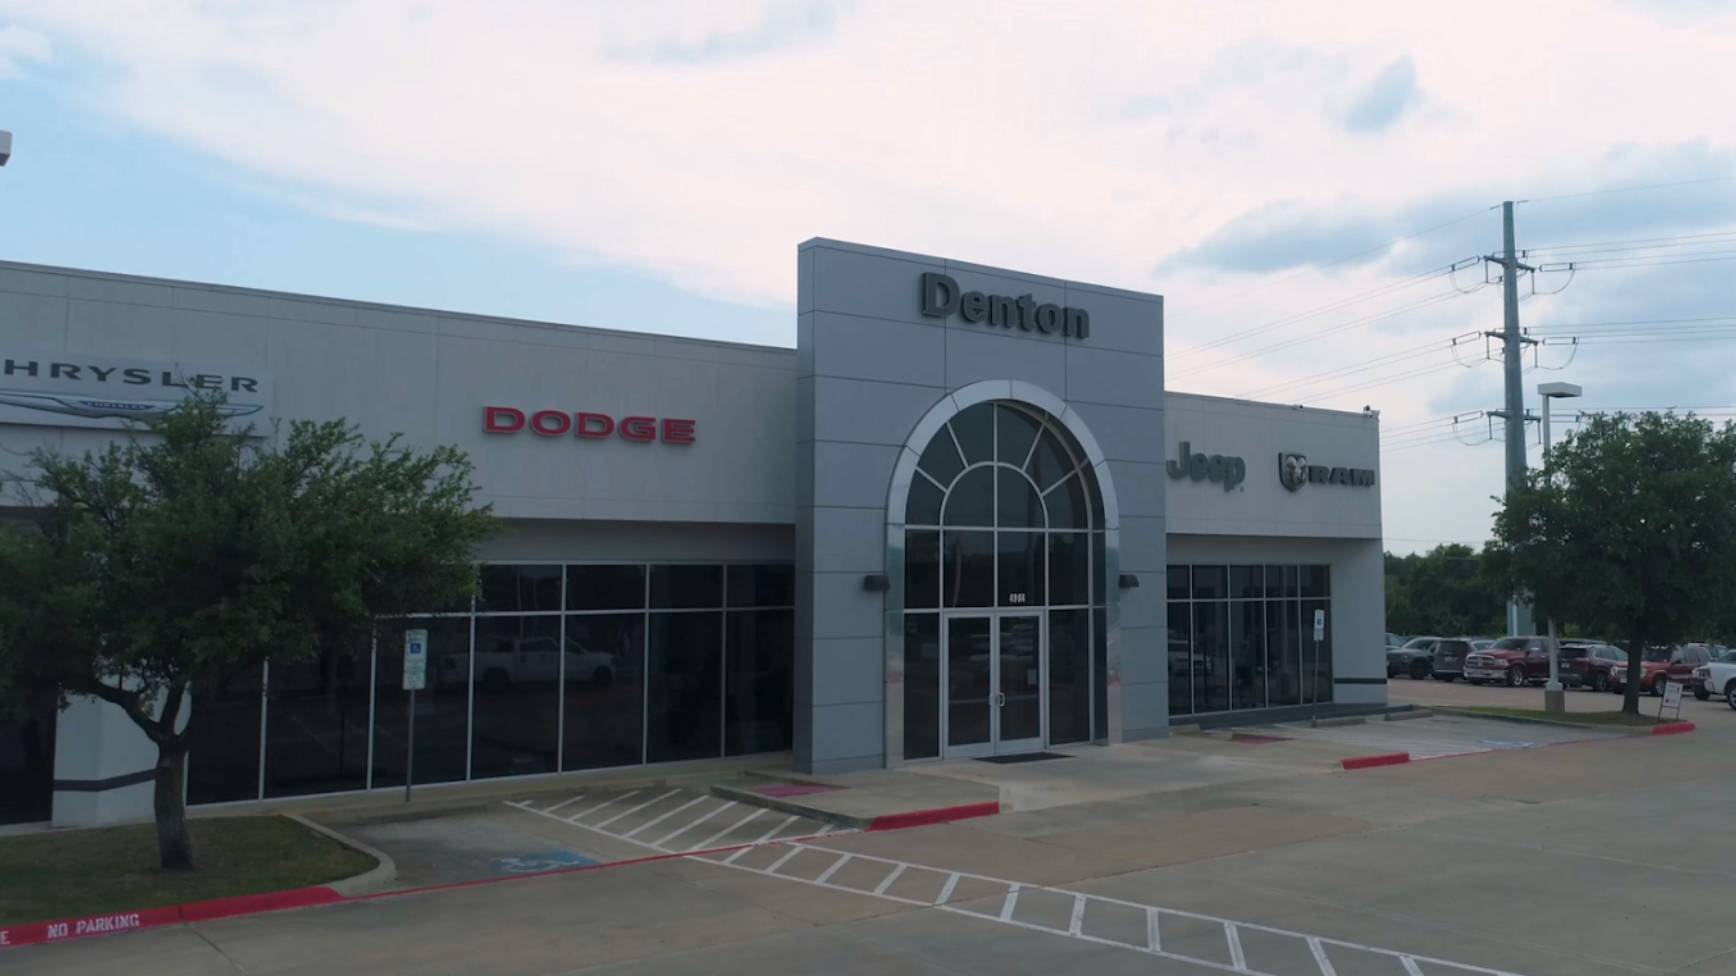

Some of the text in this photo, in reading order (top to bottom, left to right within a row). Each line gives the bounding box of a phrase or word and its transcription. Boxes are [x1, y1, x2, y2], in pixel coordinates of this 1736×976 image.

[921, 272, 1090, 339] Denton
[484, 406, 695, 445] DODGE
[1166, 440, 1246, 493] Jeep
[1309, 465, 1375, 488] RAM
[47, 923, 68, 939] NO
[76, 914, 140, 935] PARKING
